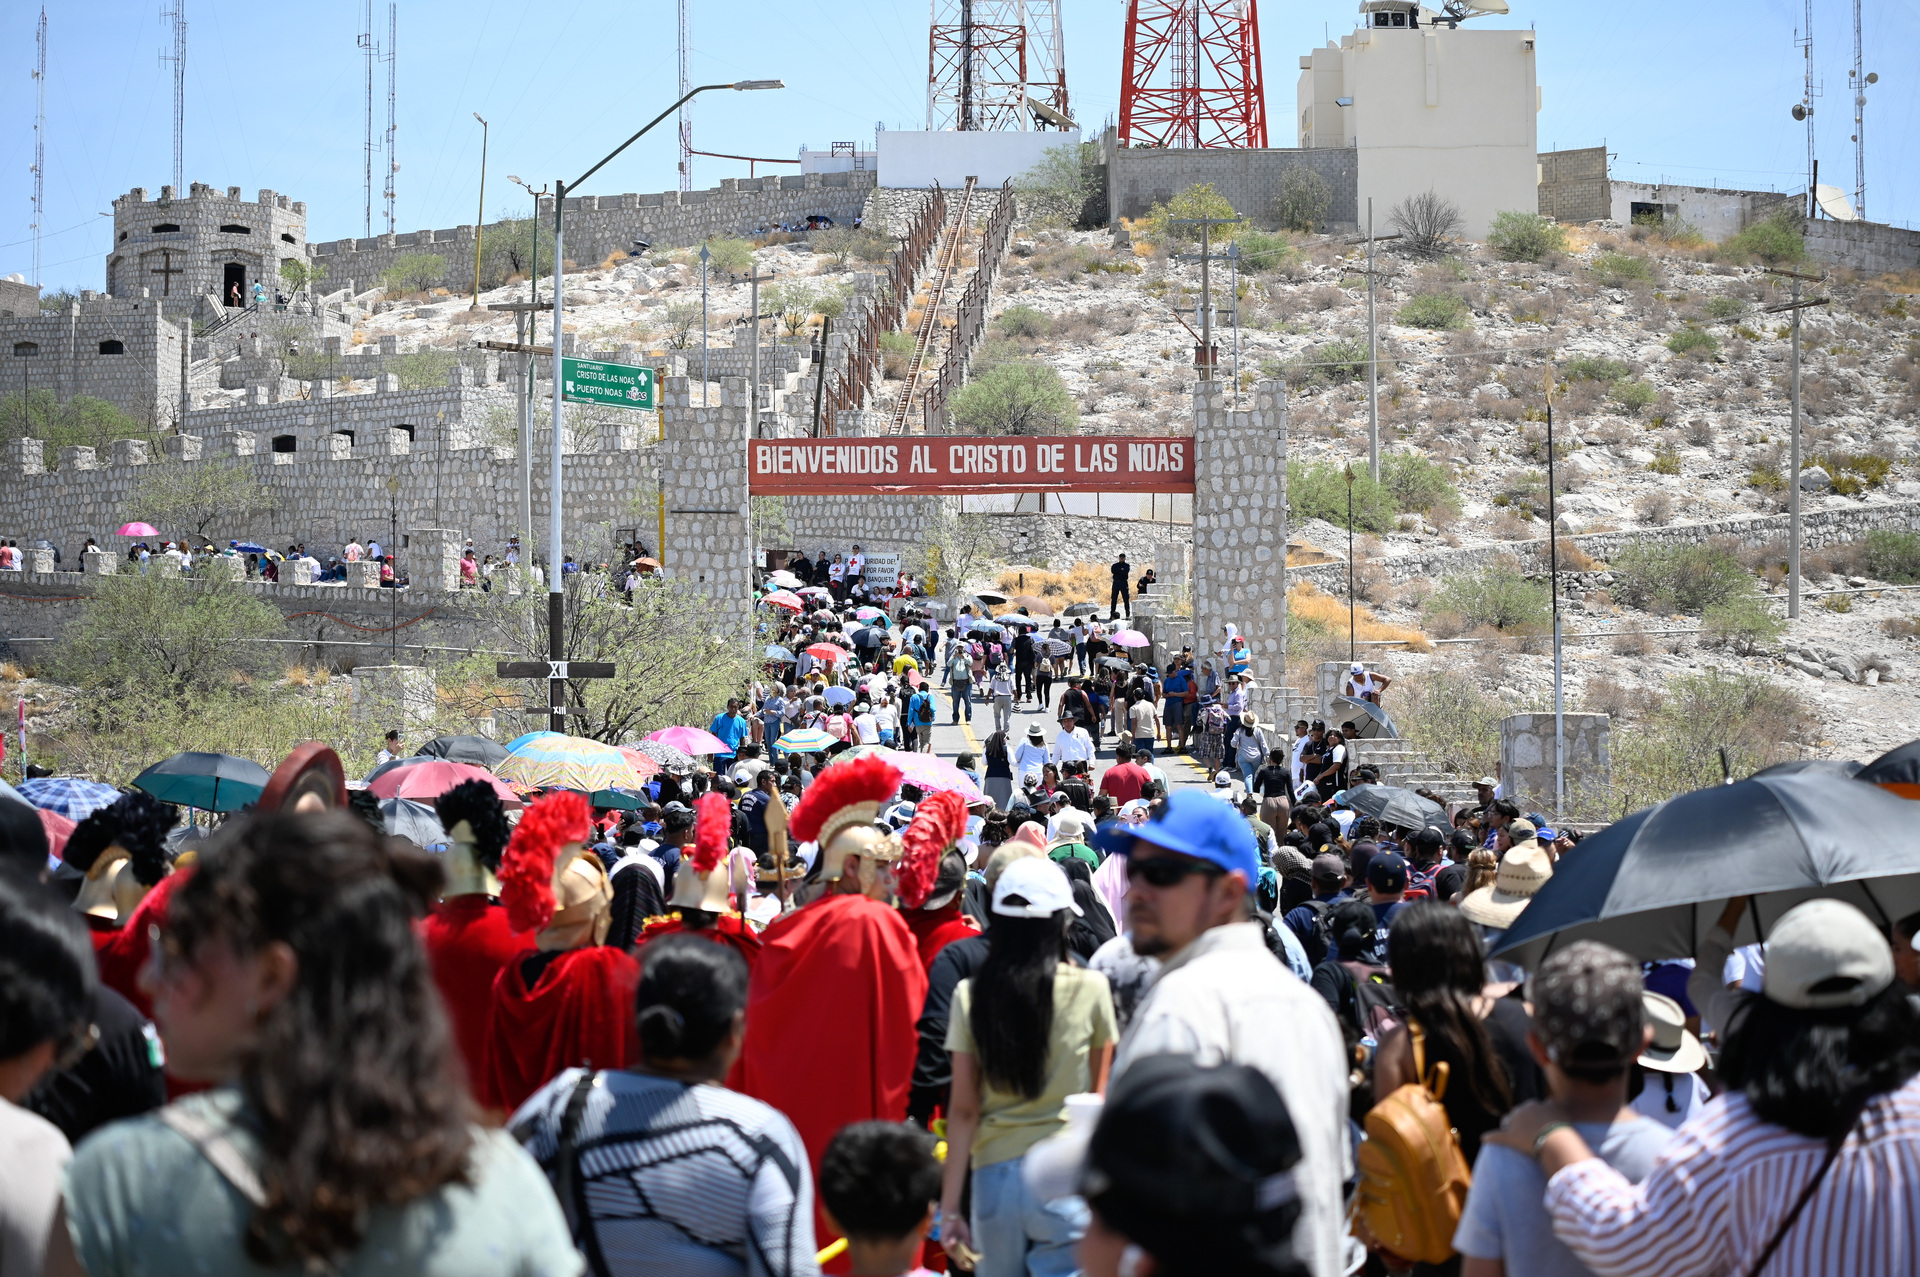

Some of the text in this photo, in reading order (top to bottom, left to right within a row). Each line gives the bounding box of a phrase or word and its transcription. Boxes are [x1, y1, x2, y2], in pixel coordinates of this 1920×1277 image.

[577, 362, 604, 371] SANTUARIO
[576, 370, 634, 385] CRISTO DE LAS NOAS
[576, 384, 622, 397] PUERTO NOAS
[756, 443, 1184, 474] BIENVENIDOS AL CRISTO DE LAS NOAS
[547, 661, 569, 678] XIII
[553, 706, 566, 715] XIII
